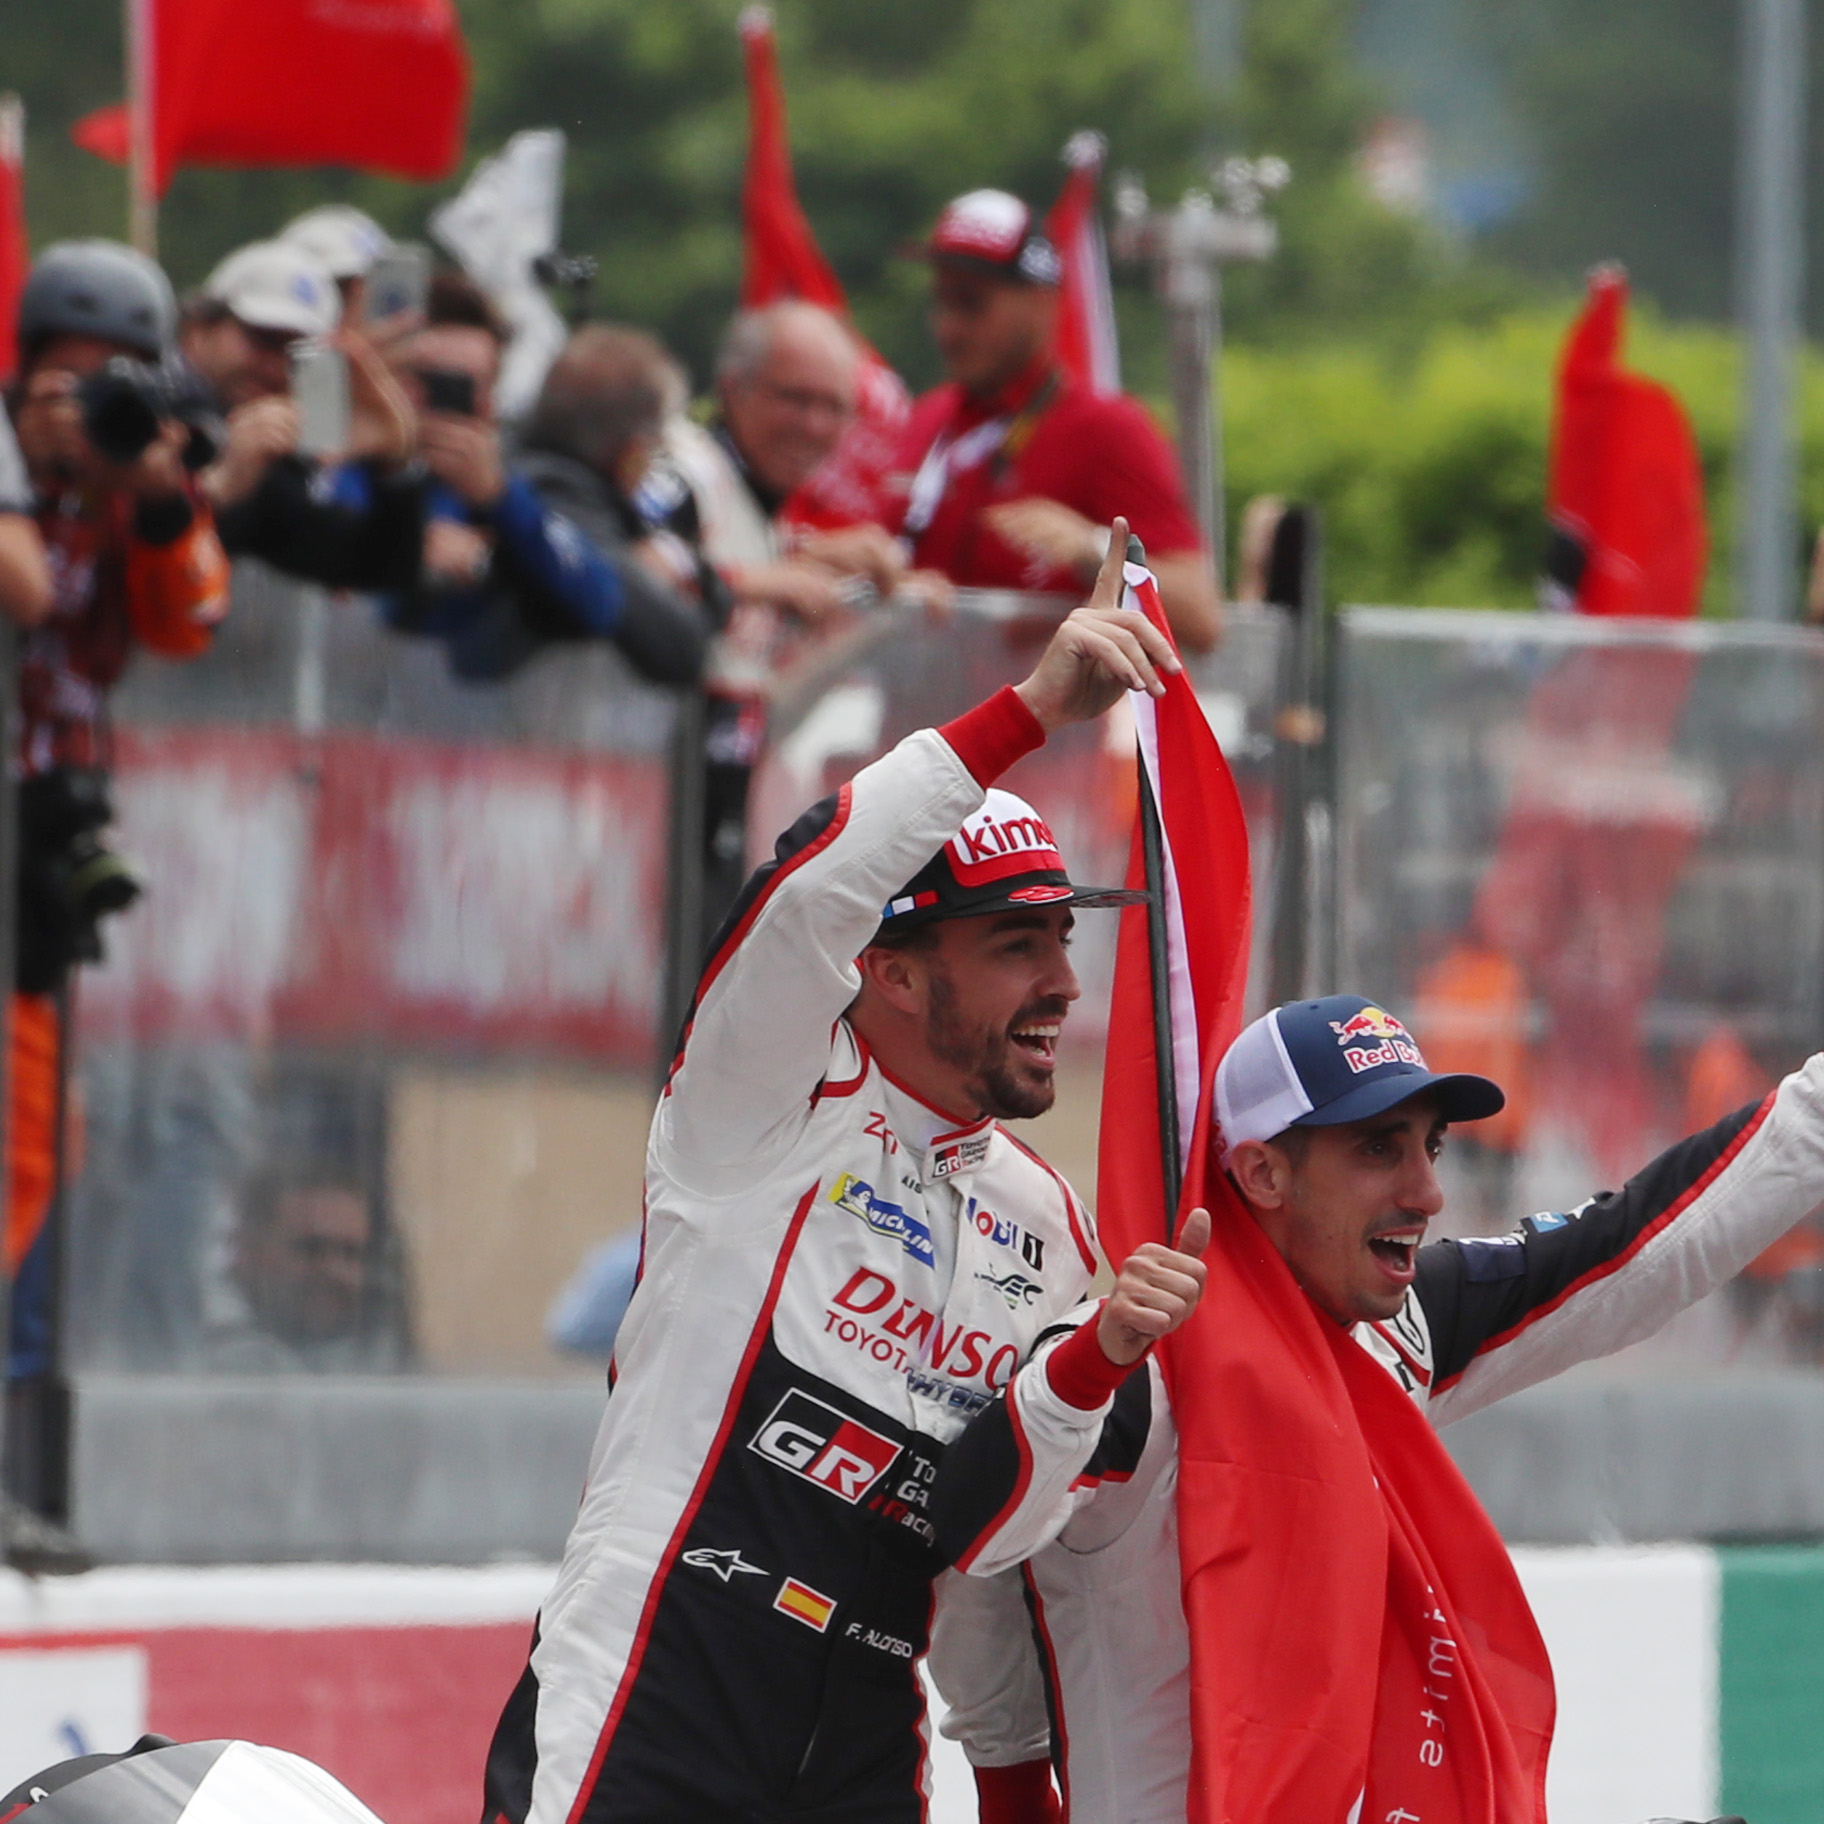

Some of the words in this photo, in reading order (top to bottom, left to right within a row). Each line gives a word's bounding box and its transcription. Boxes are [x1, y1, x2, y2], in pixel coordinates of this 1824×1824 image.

[1345, 1040, 1397, 1072] Red
[825, 1309, 909, 1374] TOYOT
[758, 1420, 876, 1498] GR
[845, 1622, 863, 1640] F.
[862, 1628, 913, 1659] ALONSO
